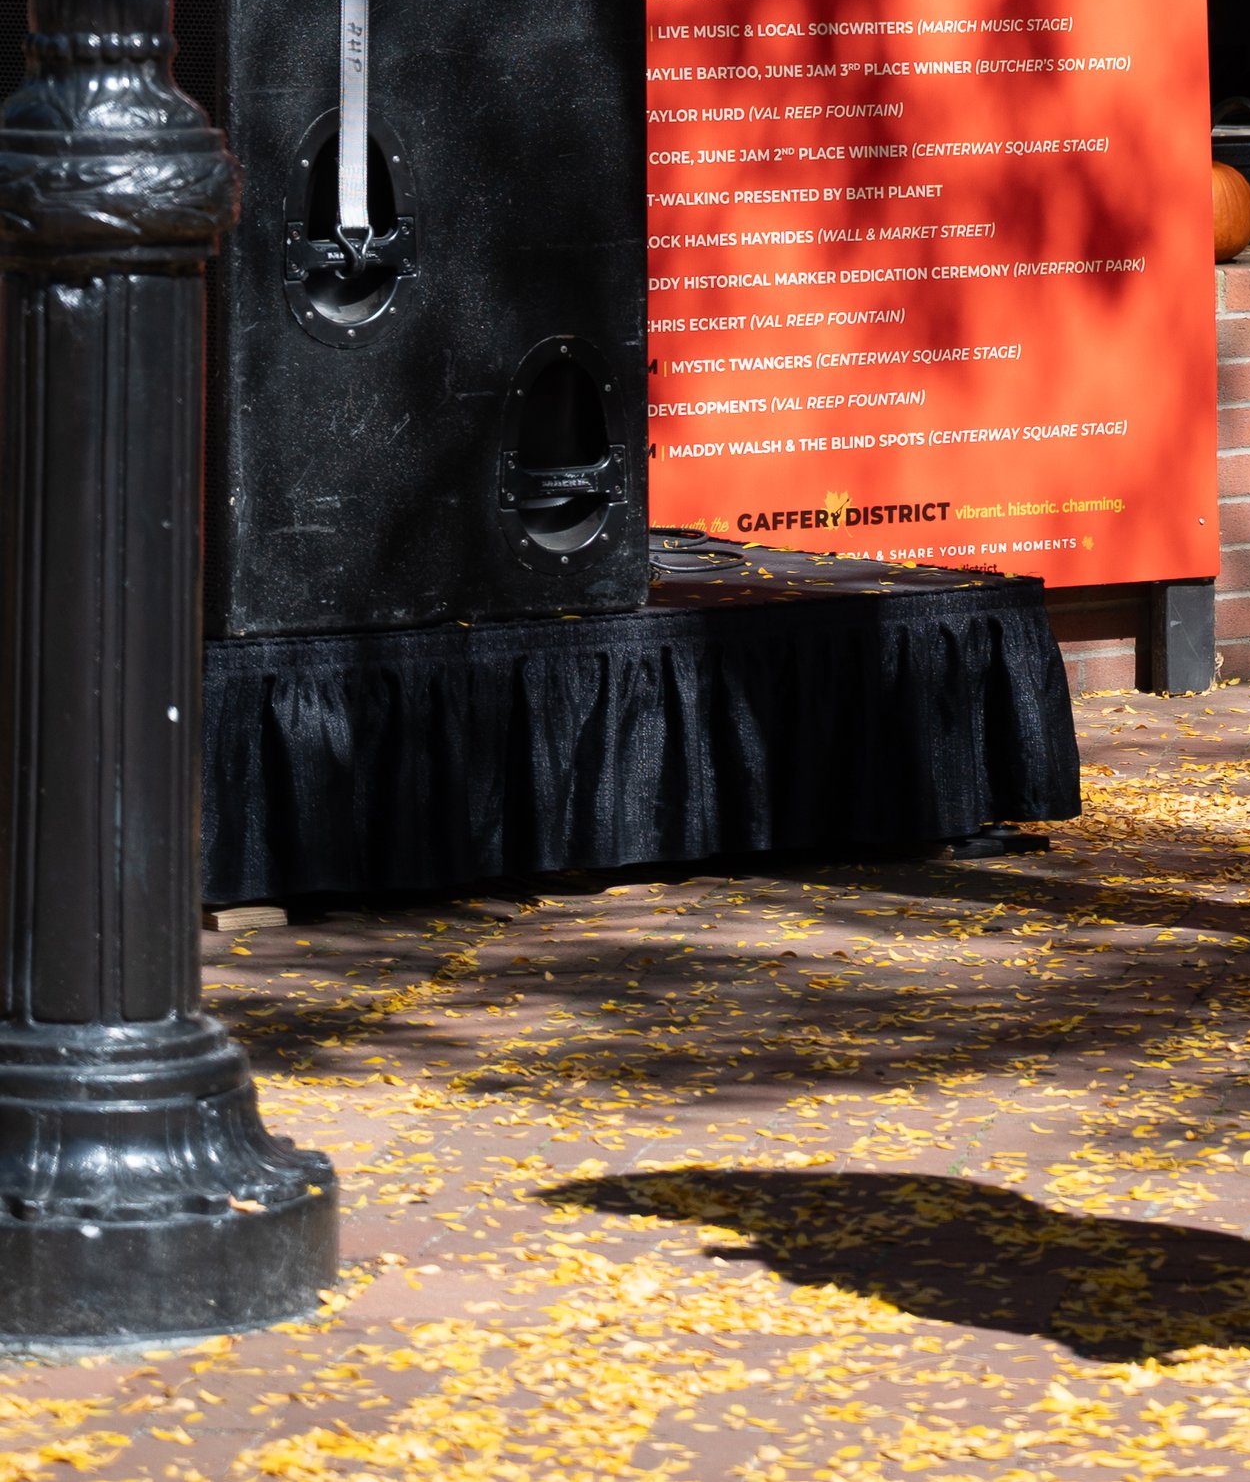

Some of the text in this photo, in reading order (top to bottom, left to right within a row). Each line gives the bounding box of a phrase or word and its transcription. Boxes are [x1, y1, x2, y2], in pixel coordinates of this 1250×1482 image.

[649, 137, 1109, 165] CORE, JUNE JAM 2ND PLACE WINNER (CENTERWAY SQUARE STAGE)
[671, 358, 725, 373] MYSTIC
[728, 355, 812, 370] TWANGERS
[816, 350, 910, 368] (CENTERWAY
[912, 347, 970, 364] SQUARE
[972, 344, 1021, 360] STAGE)
[647, 390, 925, 417] DEVELOPMENTS (VAL REEP FOUNTAIN)
[669, 443, 725, 458] MADDY
[728, 440, 781, 455] WALSH
[785, 439, 795, 452] &
[798, 437, 827, 451] THE
[831, 435, 876, 449] BLIND
[879, 432, 925, 447] SPOTS
[928, 427, 1020, 445] (CENTERWAY
[1022, 424, 1078, 441] SQUARE
[1080, 420, 1127, 436] STAGE)
[710, 496, 1126, 533] the GAFFER DISTRICT vibrant. historic. charming.
[889, 538, 1077, 561] SHARE YOUR FUN MOMENTS
